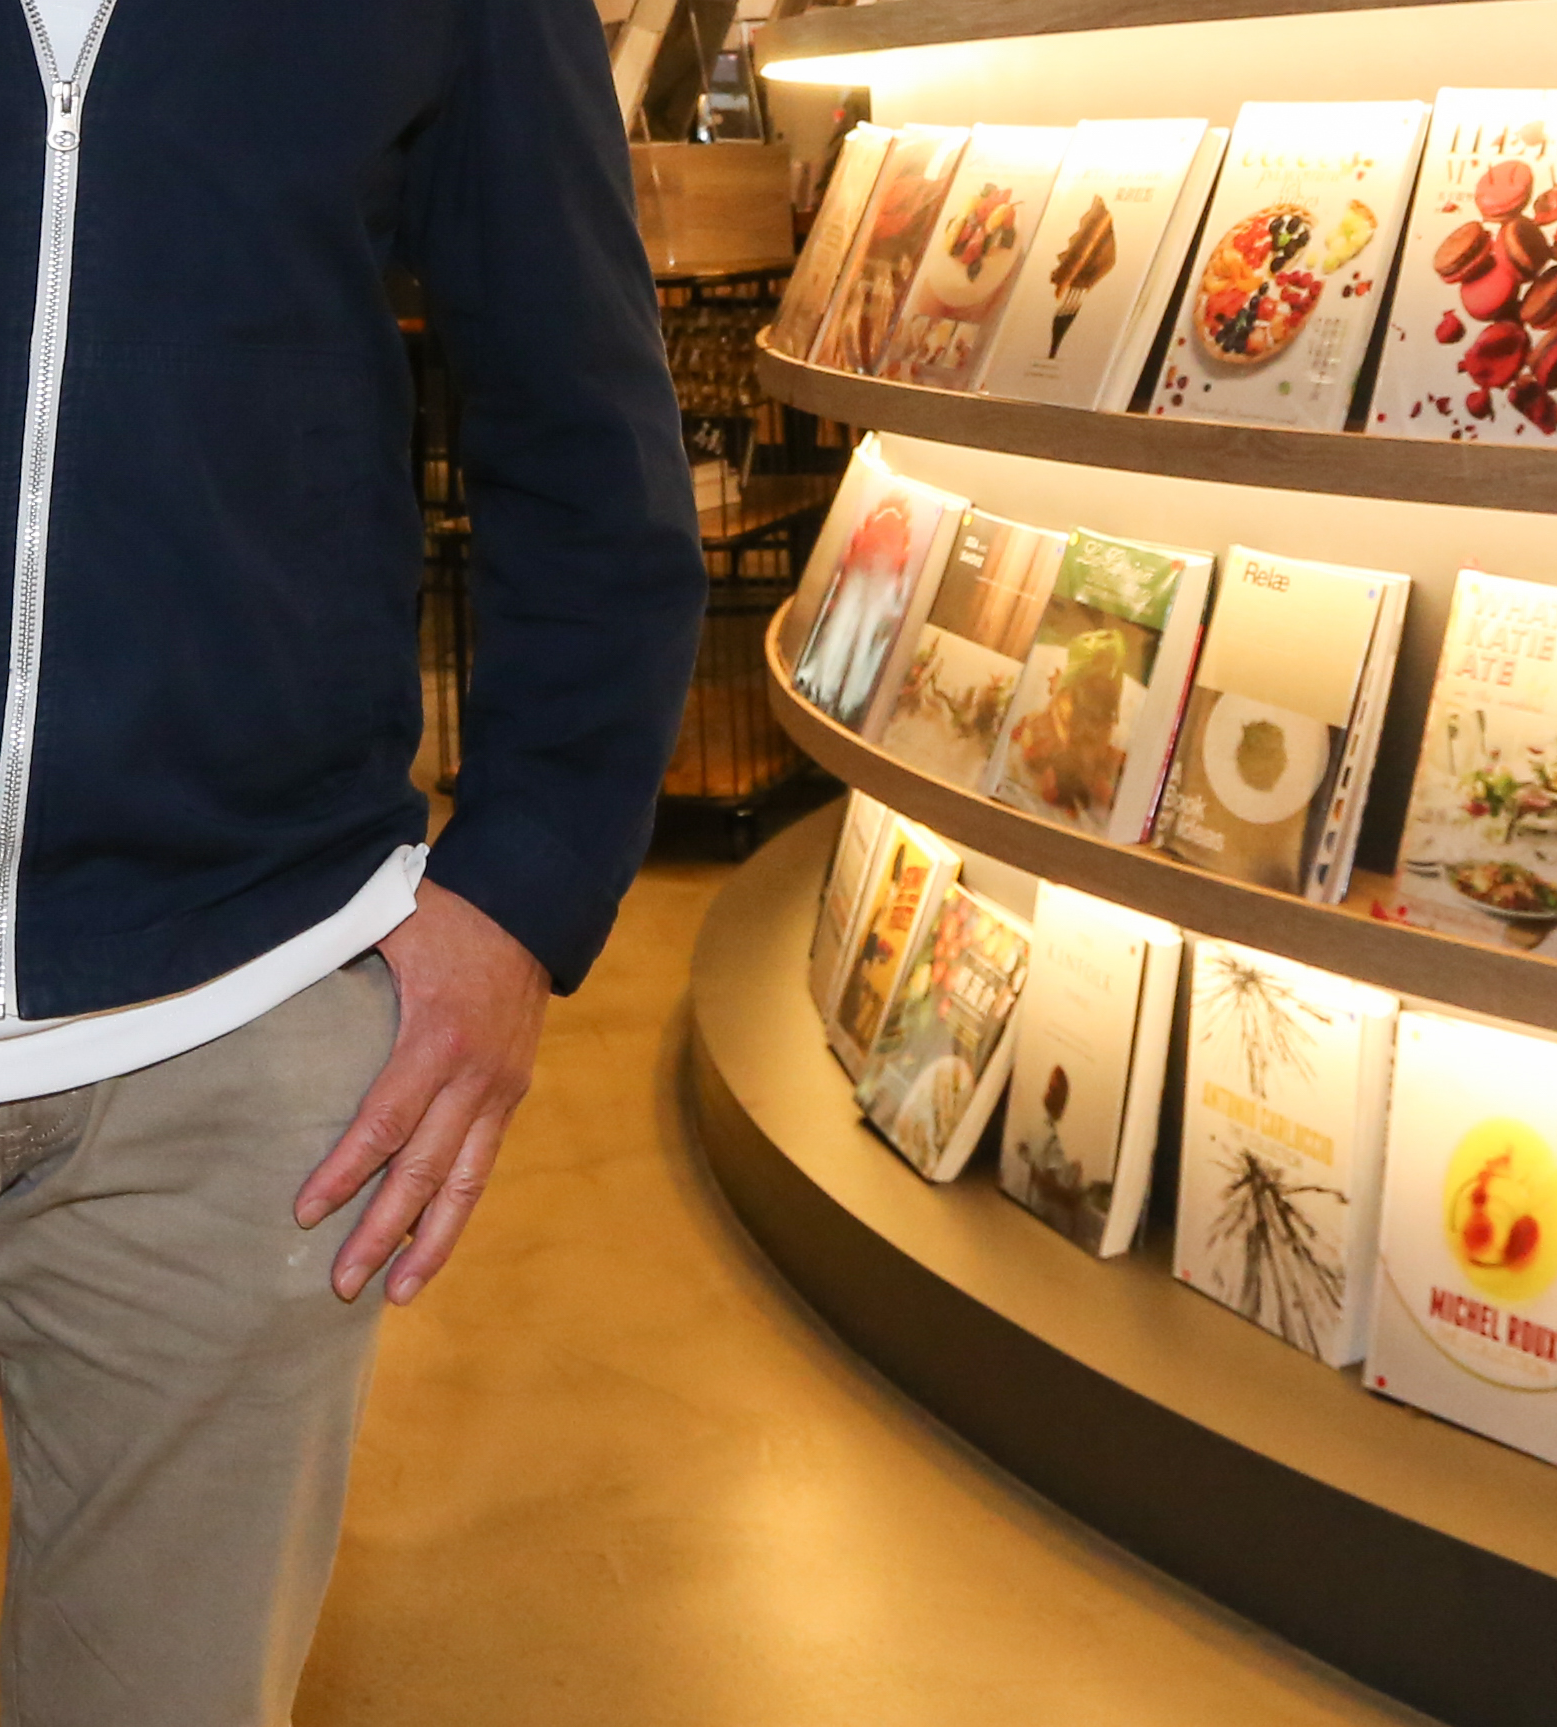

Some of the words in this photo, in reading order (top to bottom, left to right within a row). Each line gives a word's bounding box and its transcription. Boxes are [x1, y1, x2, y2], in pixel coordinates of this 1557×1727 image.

[1243, 561, 1291, 593] Relæ
[1464, 618, 1556, 662] KATIE
[1454, 651, 1516, 686] ATE
[1429, 1285, 1500, 1343] MICHEL
